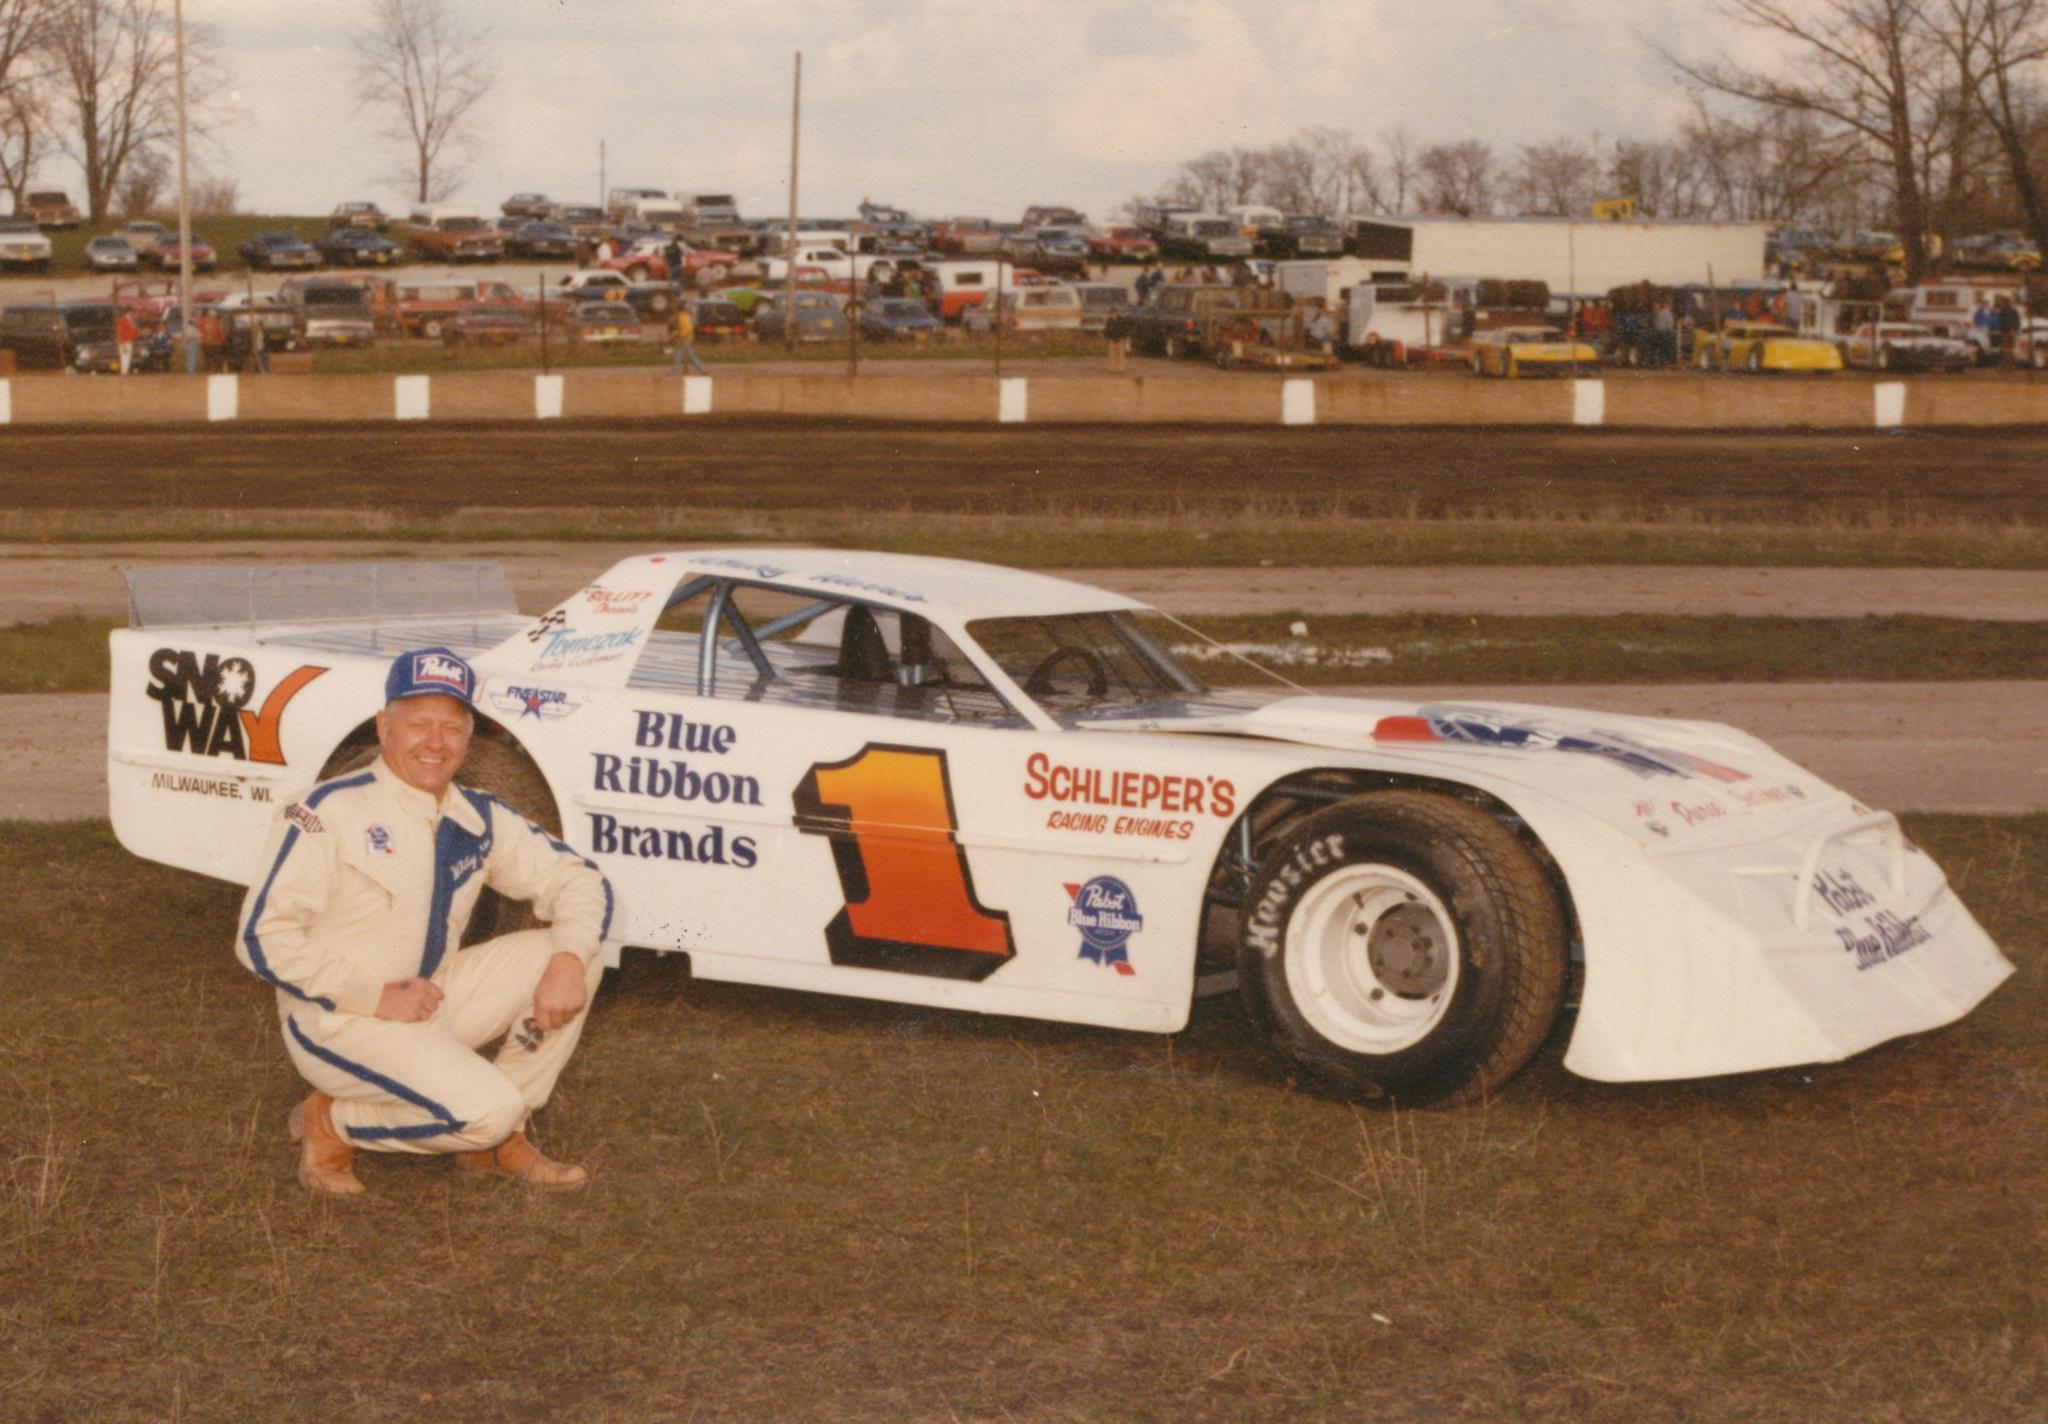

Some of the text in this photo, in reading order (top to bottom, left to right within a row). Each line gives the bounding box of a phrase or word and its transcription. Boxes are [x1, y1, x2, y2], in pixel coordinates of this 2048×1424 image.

[146, 647, 255, 708] SNO
[162, 665, 331, 766] WAY
[632, 709, 737, 754] Blue
[590, 752, 765, 806] Ribbon
[1024, 752, 1236, 818] SCHLIEPER'S
[584, 812, 759, 868] Brands
[1047, 810, 1194, 840] RACING ENGINES
[792, 741, 1018, 983] 1
[1069, 906, 1141, 932] Blue Ribbon
[1085, 884, 1126, 911] Pabst
[1246, 834, 1344, 959] Hoosier
